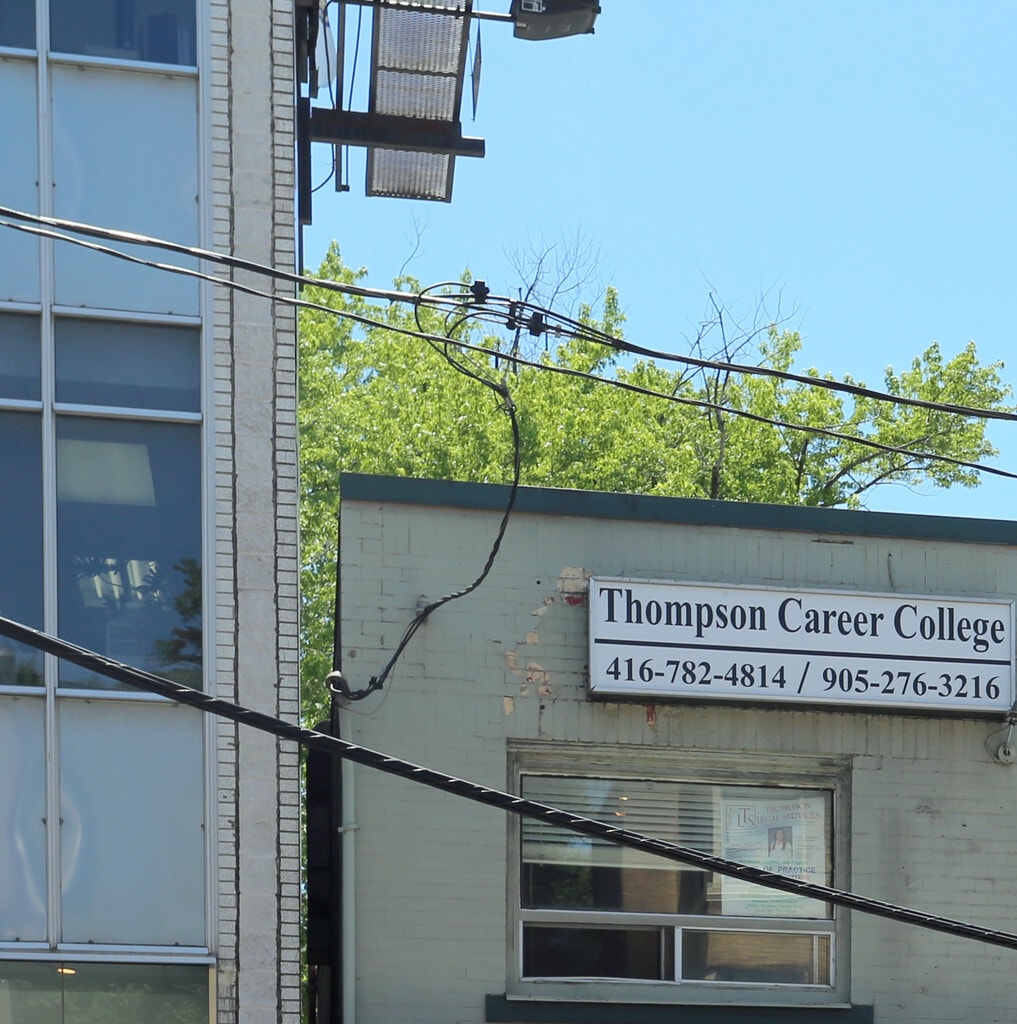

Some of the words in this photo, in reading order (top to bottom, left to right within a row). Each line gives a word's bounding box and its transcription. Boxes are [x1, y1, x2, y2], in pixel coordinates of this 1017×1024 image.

[599, 587, 767, 637] Thompson
[778, 597, 884, 636] Career
[894, 604, 1005, 653] College
[606, 656, 787, 689] 416-782-4814
[822, 667, 1001, 700] 905-276-3216
